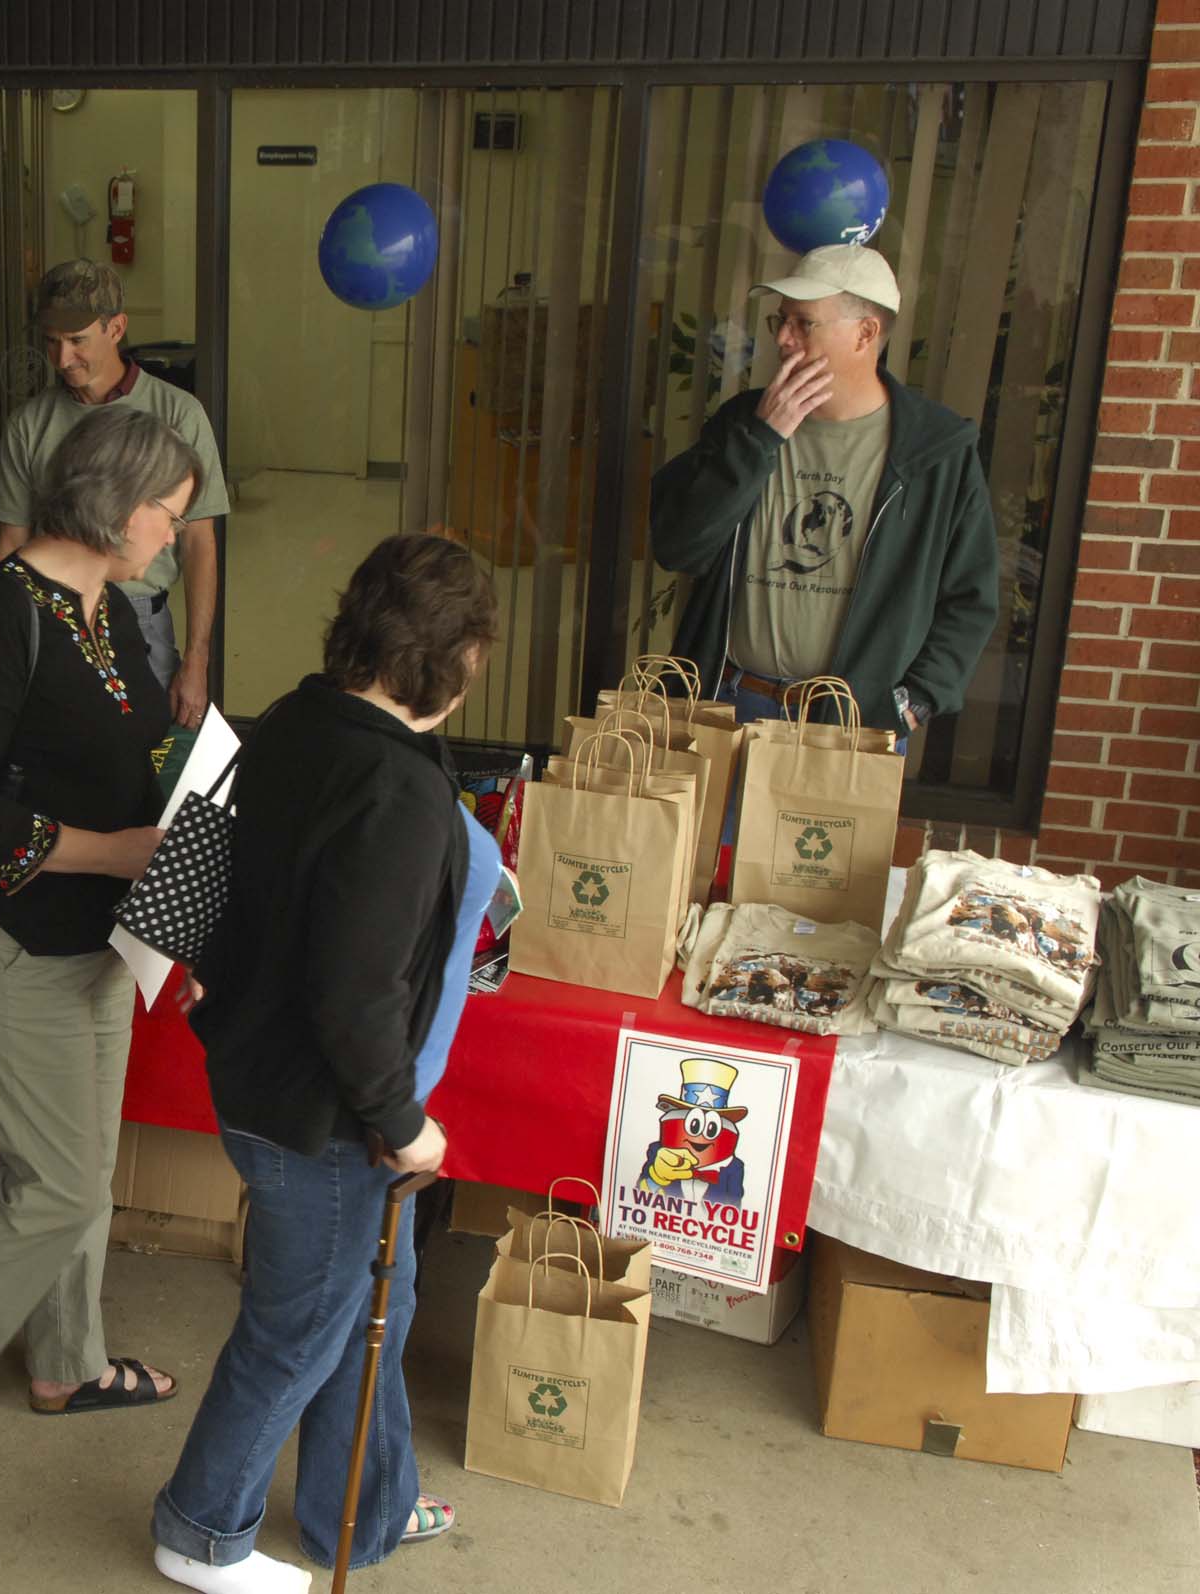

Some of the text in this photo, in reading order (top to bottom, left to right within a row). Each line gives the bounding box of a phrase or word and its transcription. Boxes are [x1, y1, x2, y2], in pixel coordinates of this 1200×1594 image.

[795, 471, 844, 485] Earth Day
[790, 581, 807, 592] Our
[780, 812, 852, 829] SUMTER RECYCLES
[557, 855, 630, 874] SUMTER RECYCLES
[1100, 1041, 1191, 1054] Conserve Our
[619, 1185, 759, 1231] I WANT YOU
[618, 1204, 757, 1252] TO RECYCLE
[629, 1225, 647, 1234] YOUR
[648, 1230, 681, 1242] NEAREST
[681, 1237, 722, 1253] RECYCLING
[722, 1248, 754, 1260] CENTER
[655, 1278, 681, 1294] PART
[512, 1368, 587, 1389] SUMTER RECYCLES
